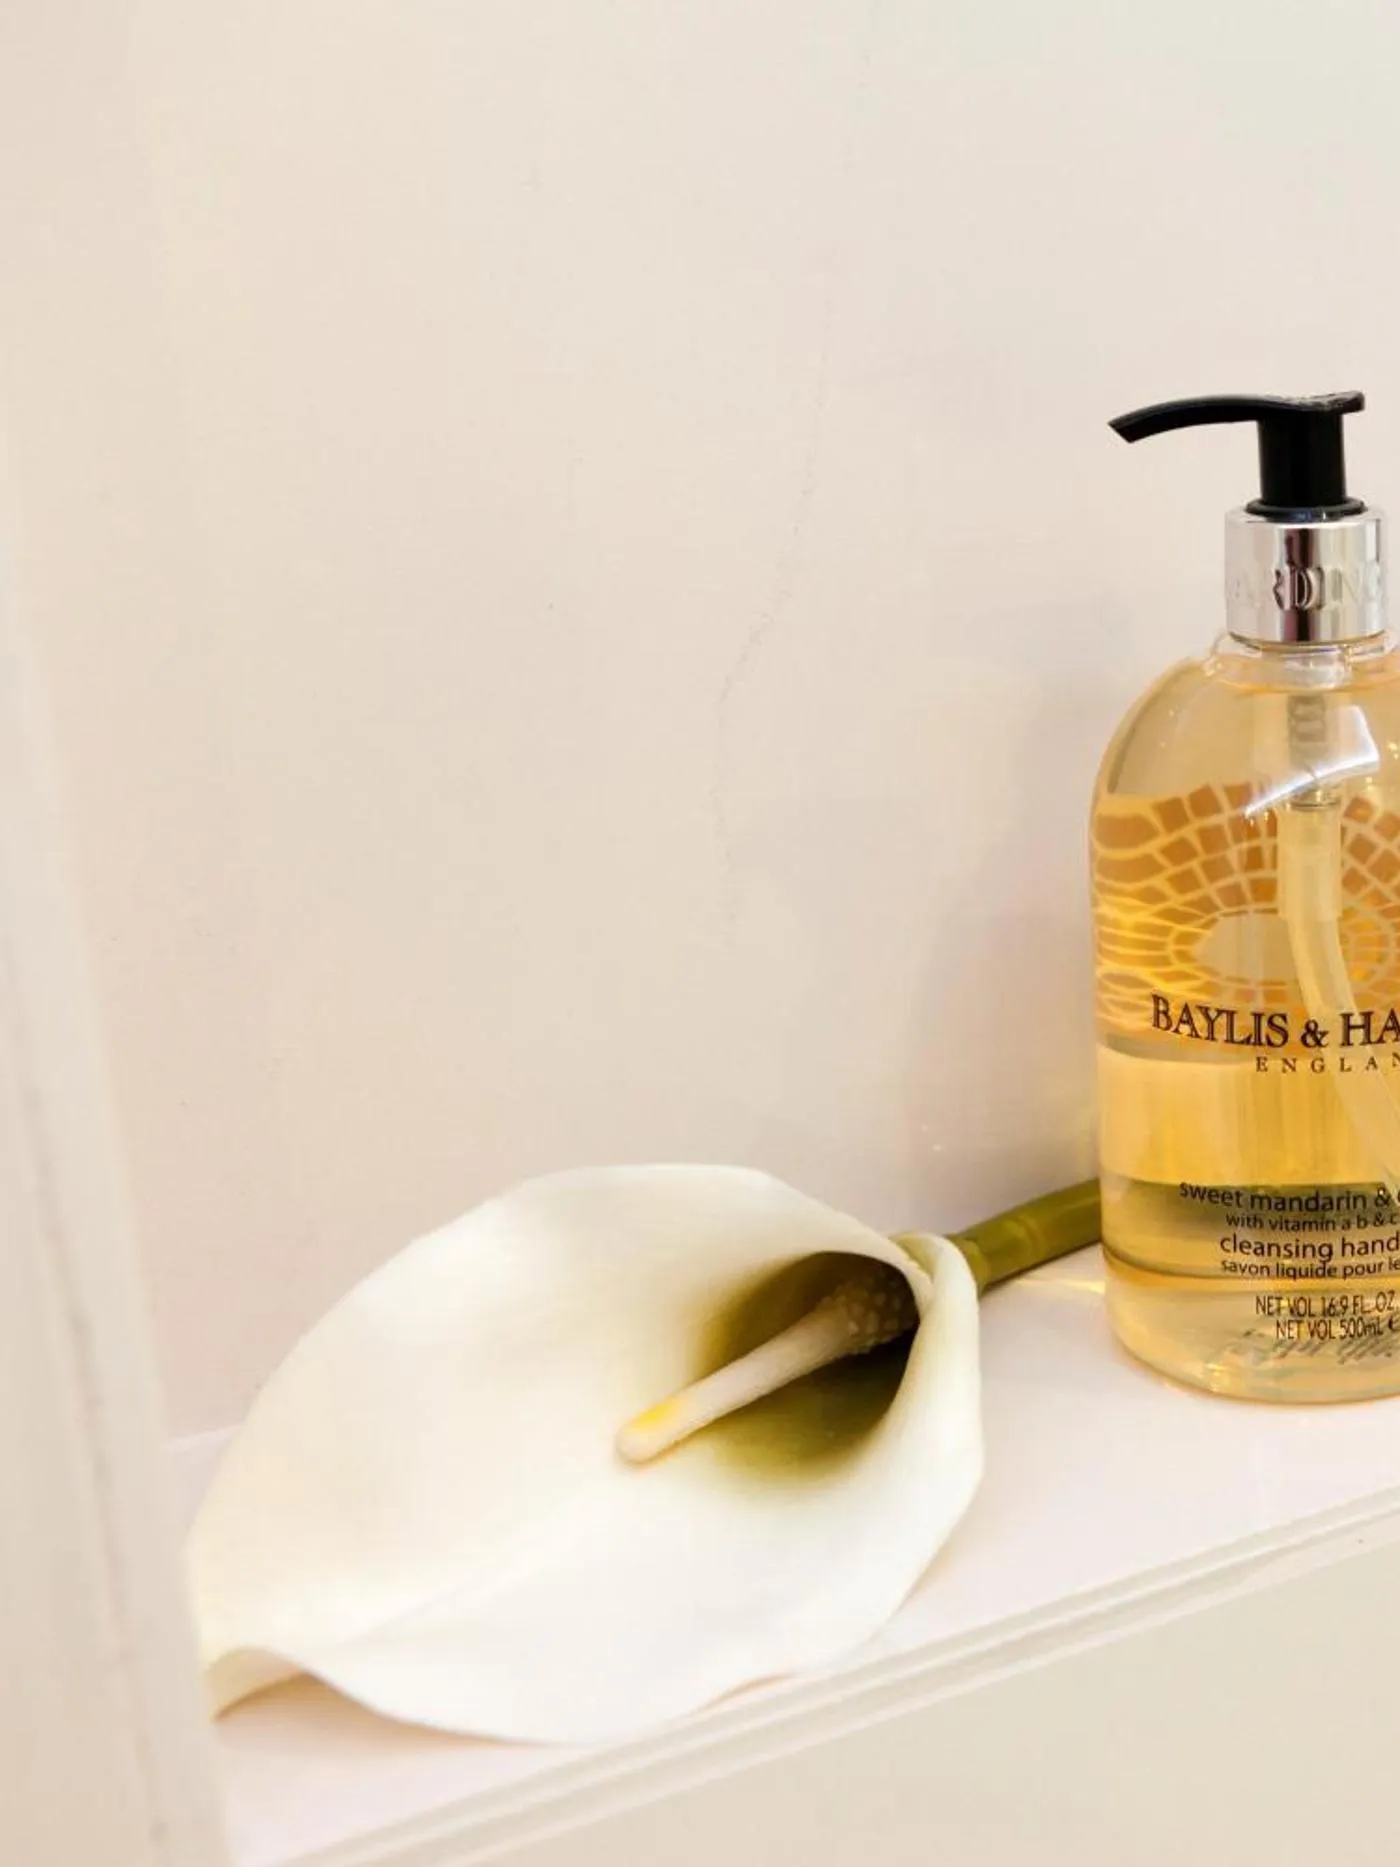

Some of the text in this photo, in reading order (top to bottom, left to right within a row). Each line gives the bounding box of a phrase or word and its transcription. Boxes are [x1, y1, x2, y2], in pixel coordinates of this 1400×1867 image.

[1151, 993, 1290, 1049] BAYLIS
[1300, 1019, 1330, 1049] &
[1180, 1182, 1244, 1209] sweet
[1250, 1189, 1367, 1213] mandarin
[1374, 1186, 1391, 1208] &
[1226, 1212, 1265, 1230] with
[1268, 1214, 1337, 1233] vitamin
[1341, 1216, 1351, 1231] a
[1356, 1213, 1368, 1230] b
[1373, 1212, 1385, 1228] &
[1390, 1212, 1398, 1226] c
[1220, 1232, 1334, 1263] cleansing
[1341, 1230, 1400, 1258] hand
[1221, 1258, 1271, 1277] savon
[1276, 1261, 1337, 1281] liquide
[1343, 1259, 1384, 1281] pour
[1255, 1295, 1283, 1316] NET
[1286, 1295, 1316, 1318] VOL
[1321, 1294, 1350, 1318] 16.9
[1276, 1319, 1302, 1340] NET
[1307, 1319, 1336, 1341] VOL
[1340, 1317, 1384, 1341] 500mL
